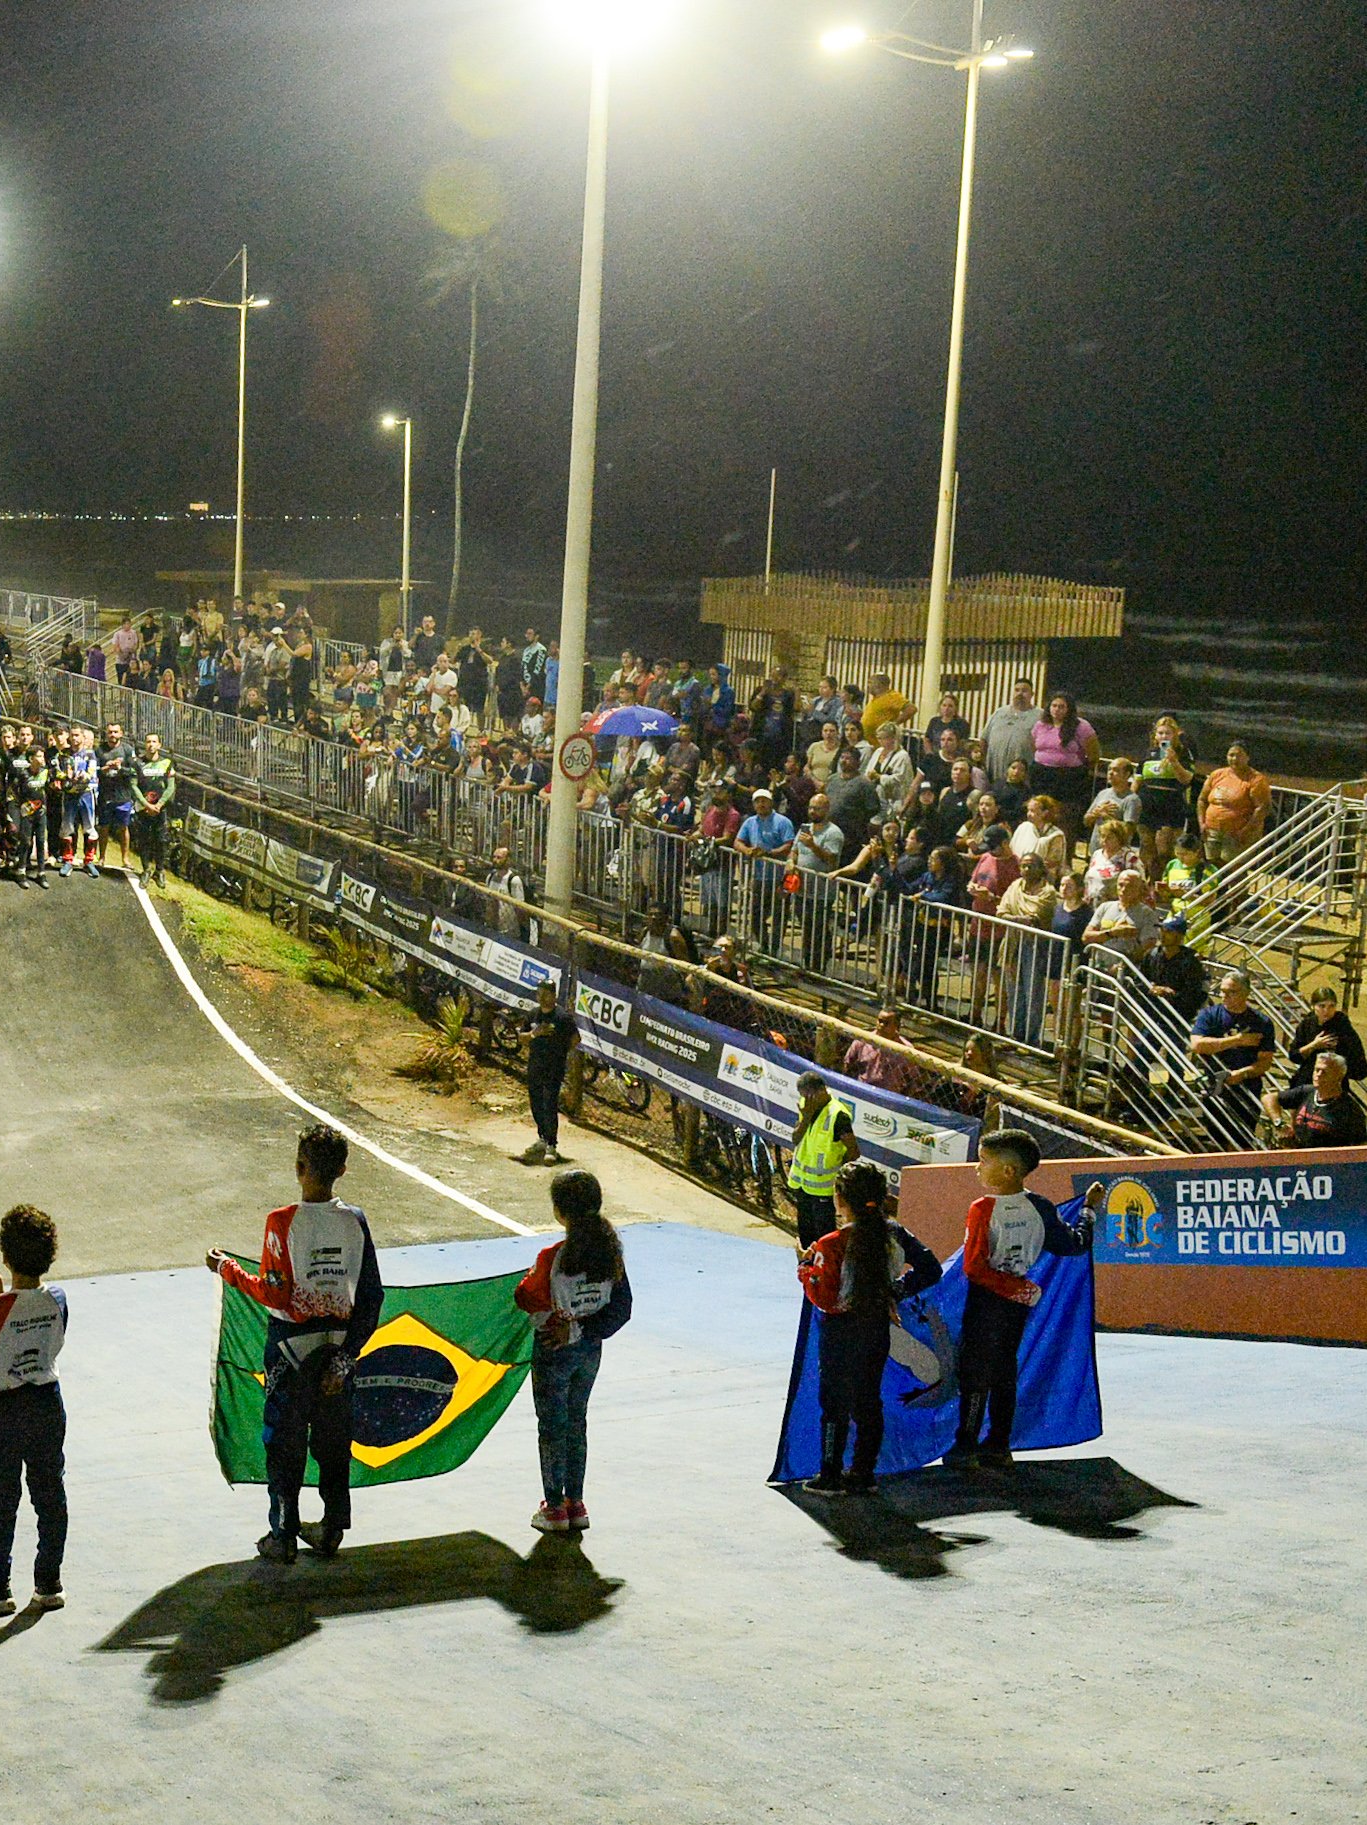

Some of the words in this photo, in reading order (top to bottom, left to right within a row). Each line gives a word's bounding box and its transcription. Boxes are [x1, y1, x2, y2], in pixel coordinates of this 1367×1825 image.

[348, 881, 371, 908] CBC
[589, 994, 625, 1029] CBC
[657, 1037, 678, 1054] RACING
[677, 1046, 698, 1062] 2025
[674, 1027, 711, 1052] BRASILEIRO
[710, 1095, 742, 1113] cbc.esp.br
[1175, 1169, 1333, 1209] FEDERAÇÃO
[1177, 1204, 1282, 1229] BAIANA
[1177, 1231, 1210, 1255] DE
[1218, 1230, 1347, 1256] CICLISMO
